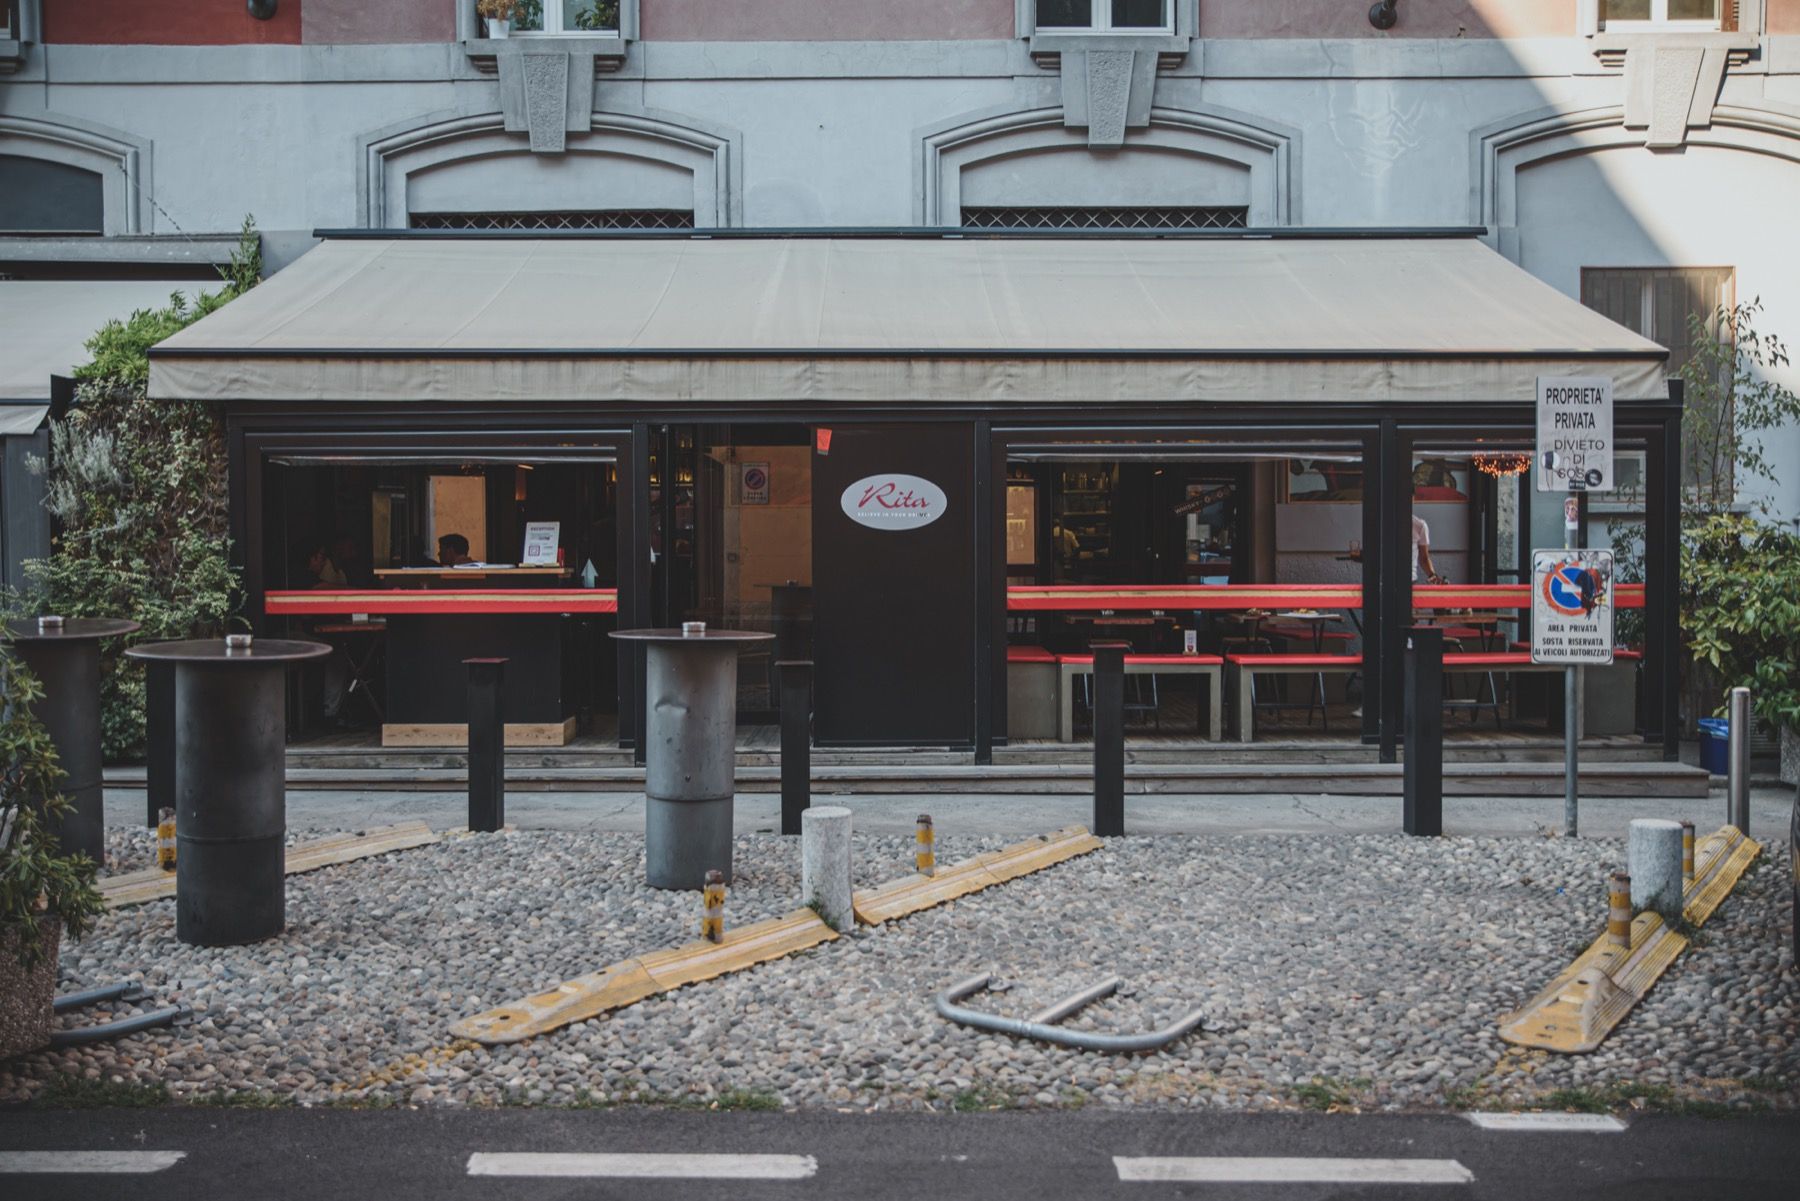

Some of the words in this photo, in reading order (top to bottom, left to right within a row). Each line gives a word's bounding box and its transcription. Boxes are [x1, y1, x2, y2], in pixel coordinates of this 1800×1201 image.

[1546, 387, 1604, 405] PROPRIETA'
[1554, 412, 1596, 429] PRIVATA
[1554, 439, 1605, 450] DIVIETO
[1573, 454, 1585, 465] DI
[1558, 468, 1586, 479] SOS
[858, 482, 931, 509] Rita
[1547, 624, 1565, 632] AREA
[1569, 624, 1597, 632] PRIVATA
[1542, 637, 1563, 646] SOSTA
[1568, 637, 1604, 646] RISERVATA
[1534, 648, 1541, 656] AI
[1543, 648, 1568, 656] VEICOLI
[1570, 648, 1610, 656] AUTORIZZATI
